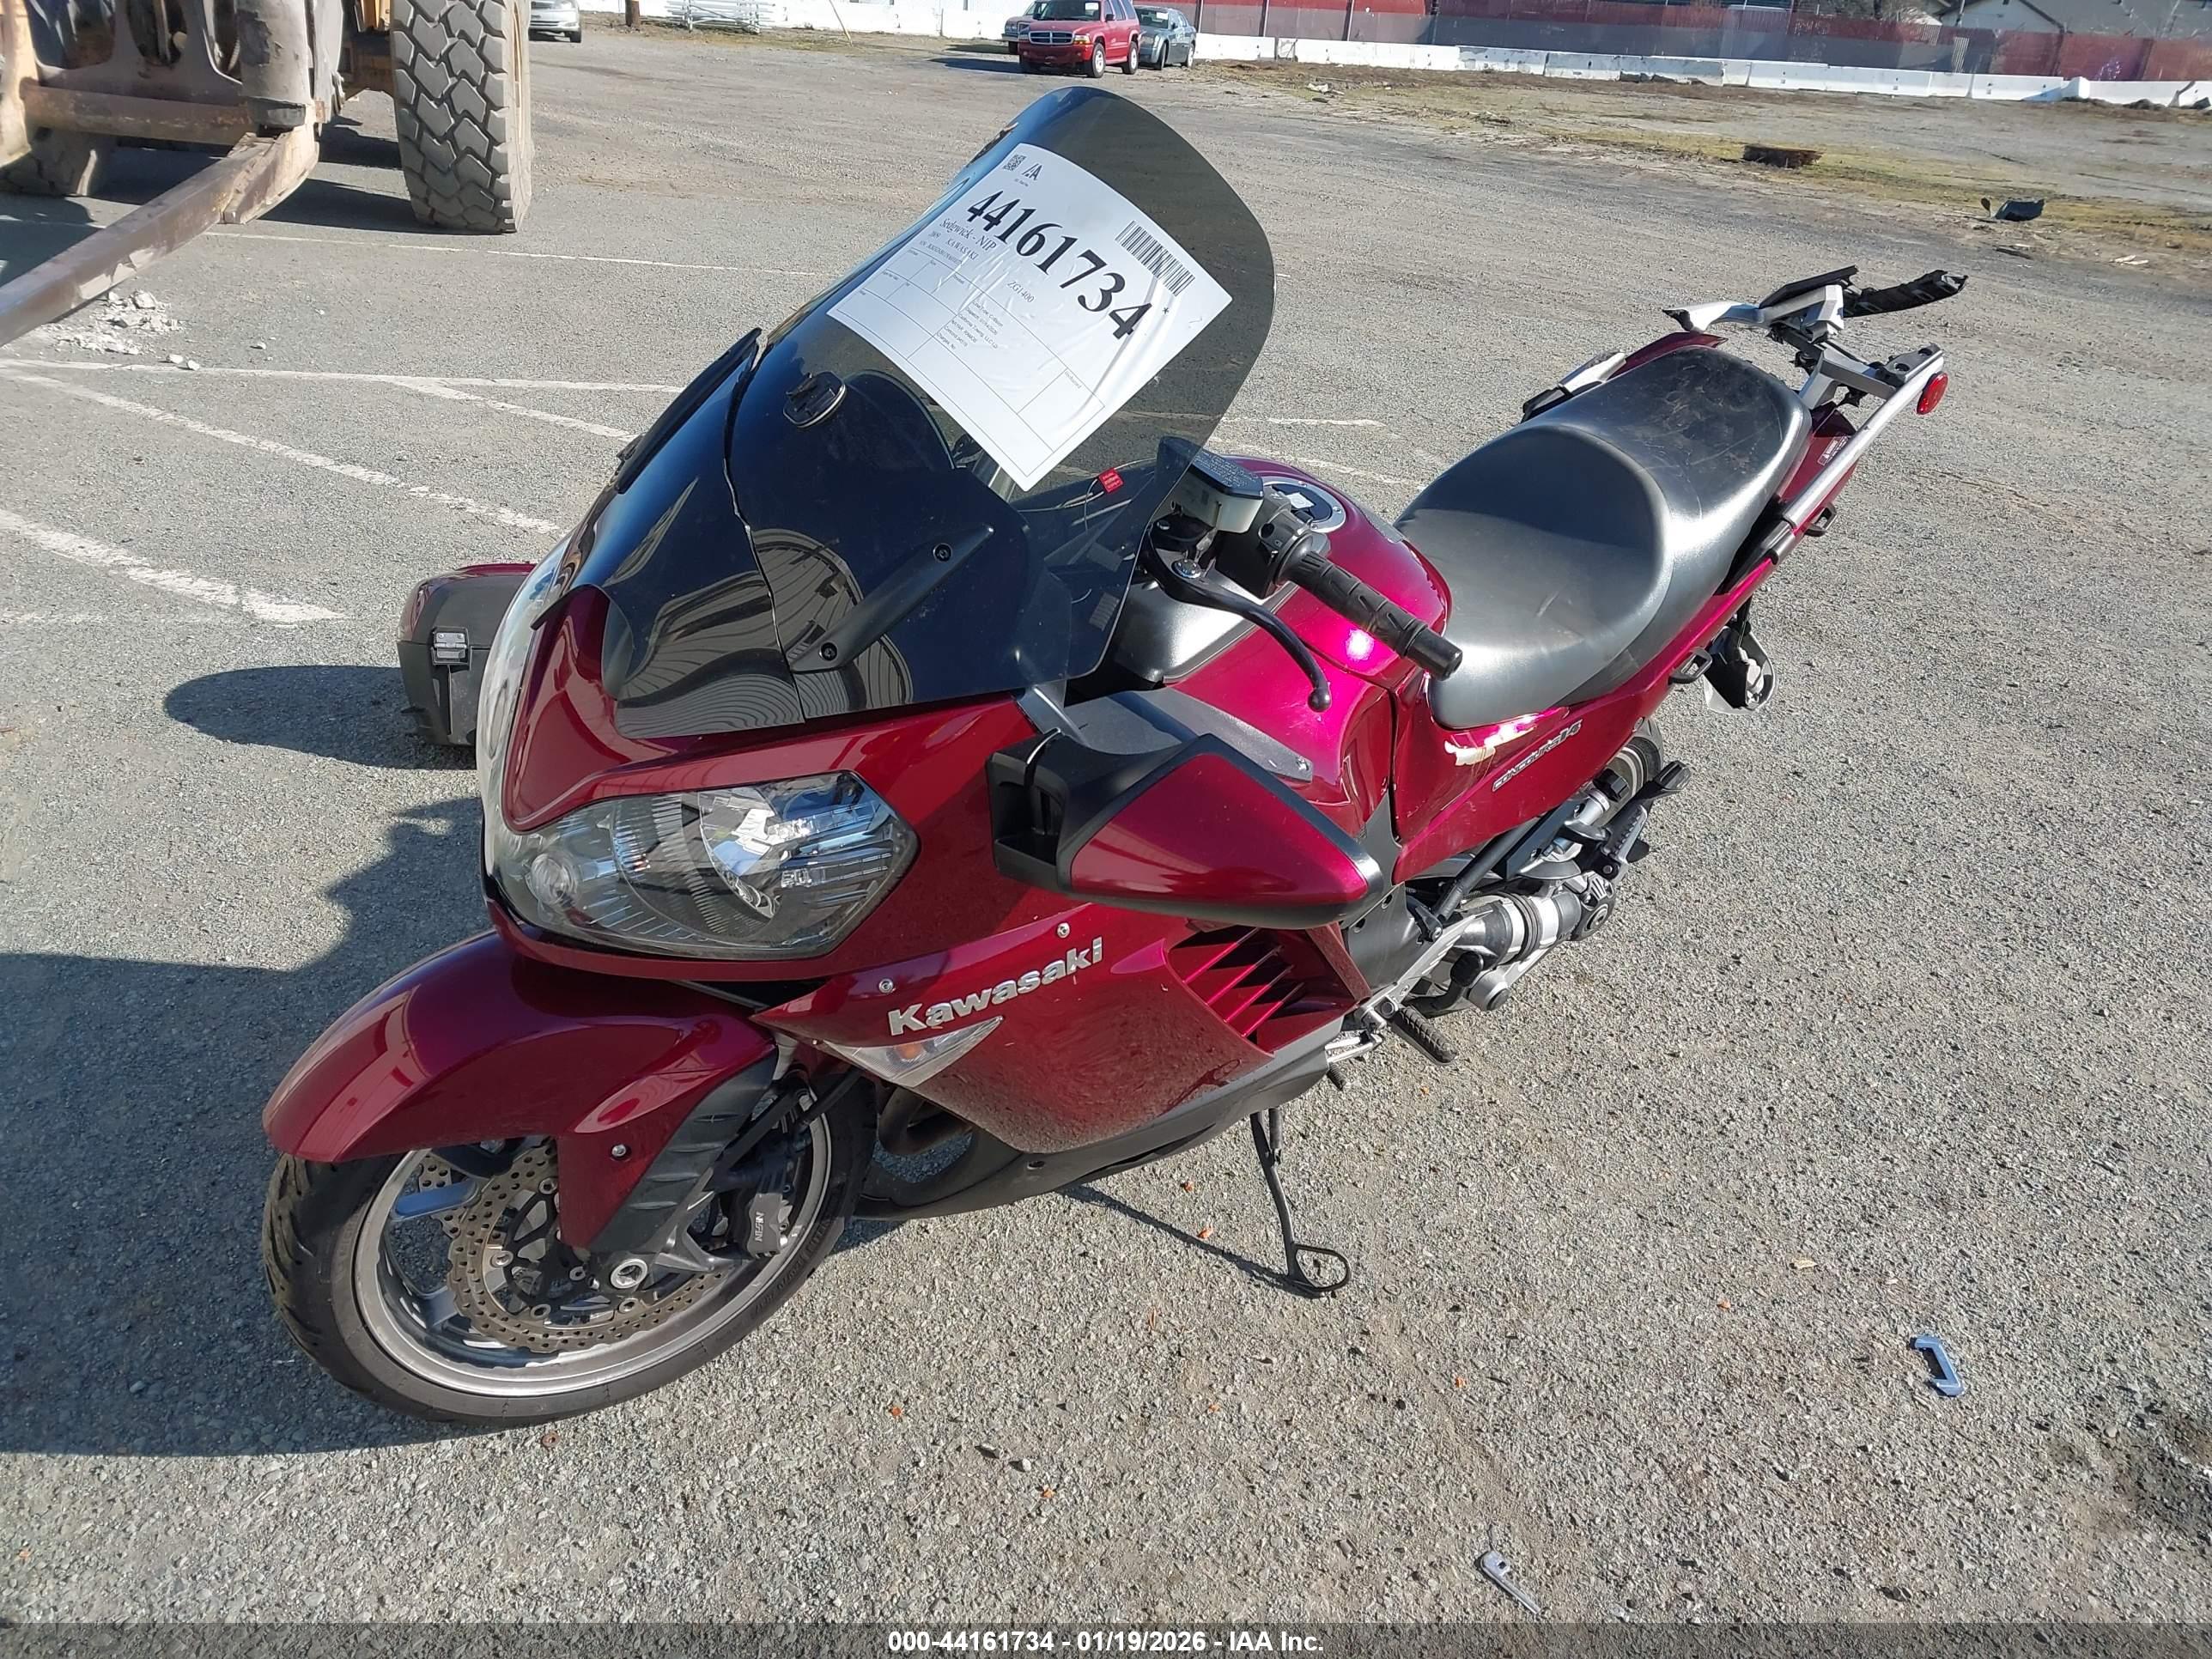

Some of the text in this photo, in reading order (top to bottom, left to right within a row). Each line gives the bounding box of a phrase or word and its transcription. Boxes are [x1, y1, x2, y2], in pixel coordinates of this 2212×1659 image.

[939, 217, 975, 240] Sedgwick
[975, 234, 997, 251] NIP
[946, 237, 979, 260] KAWASAKI
[965, 191, 1153, 340] 44161734
[1006, 281, 1036, 302] ZG1400
[888, 936, 1103, 1036] Kawasaki
